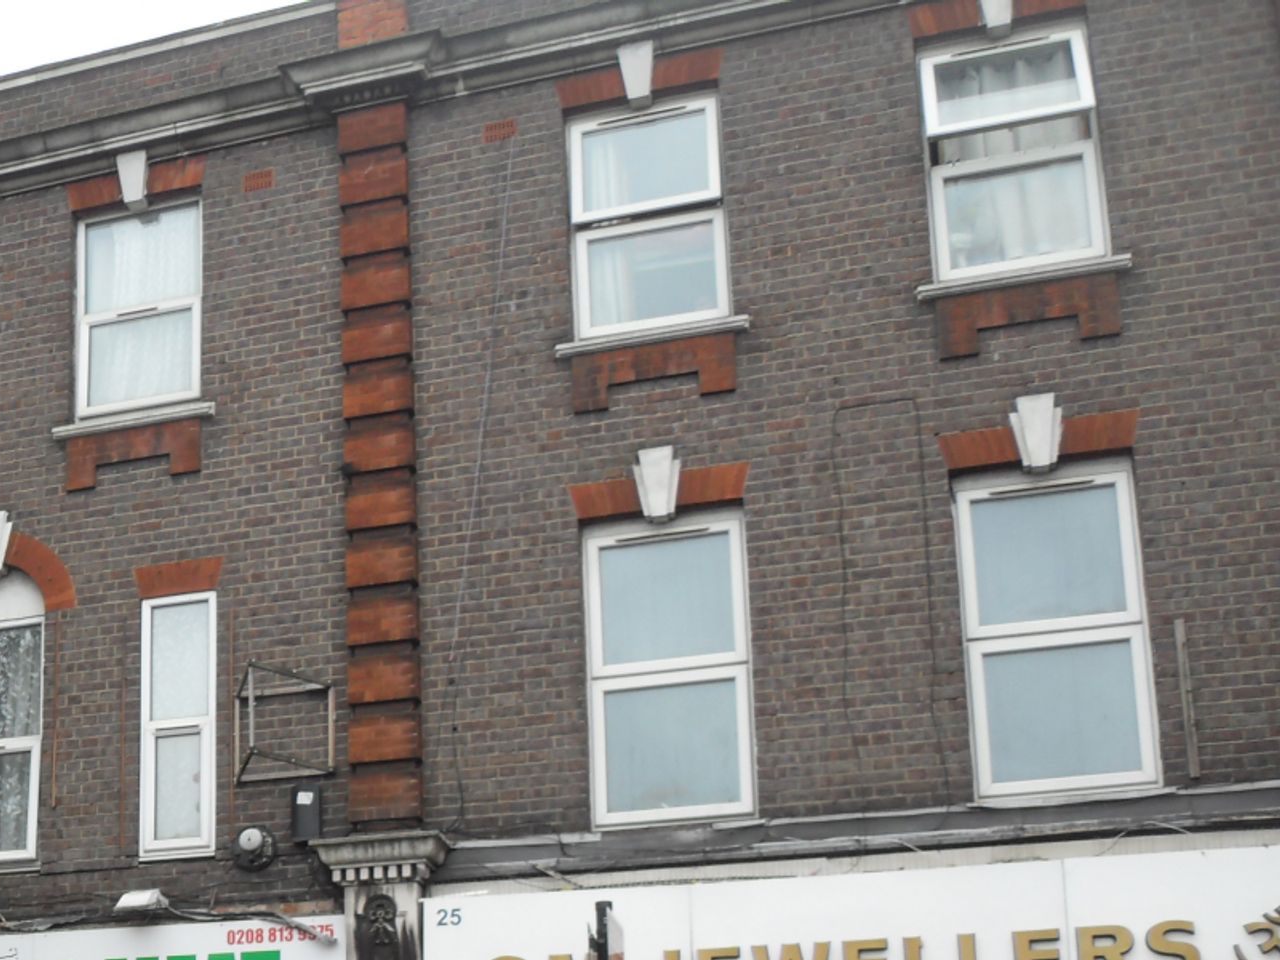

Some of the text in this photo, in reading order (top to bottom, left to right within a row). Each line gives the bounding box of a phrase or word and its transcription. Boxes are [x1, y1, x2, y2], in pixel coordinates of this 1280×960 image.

[436, 908, 462, 926] 25
[227, 928, 264, 945] 0208
[268, 926, 294, 943] 813
